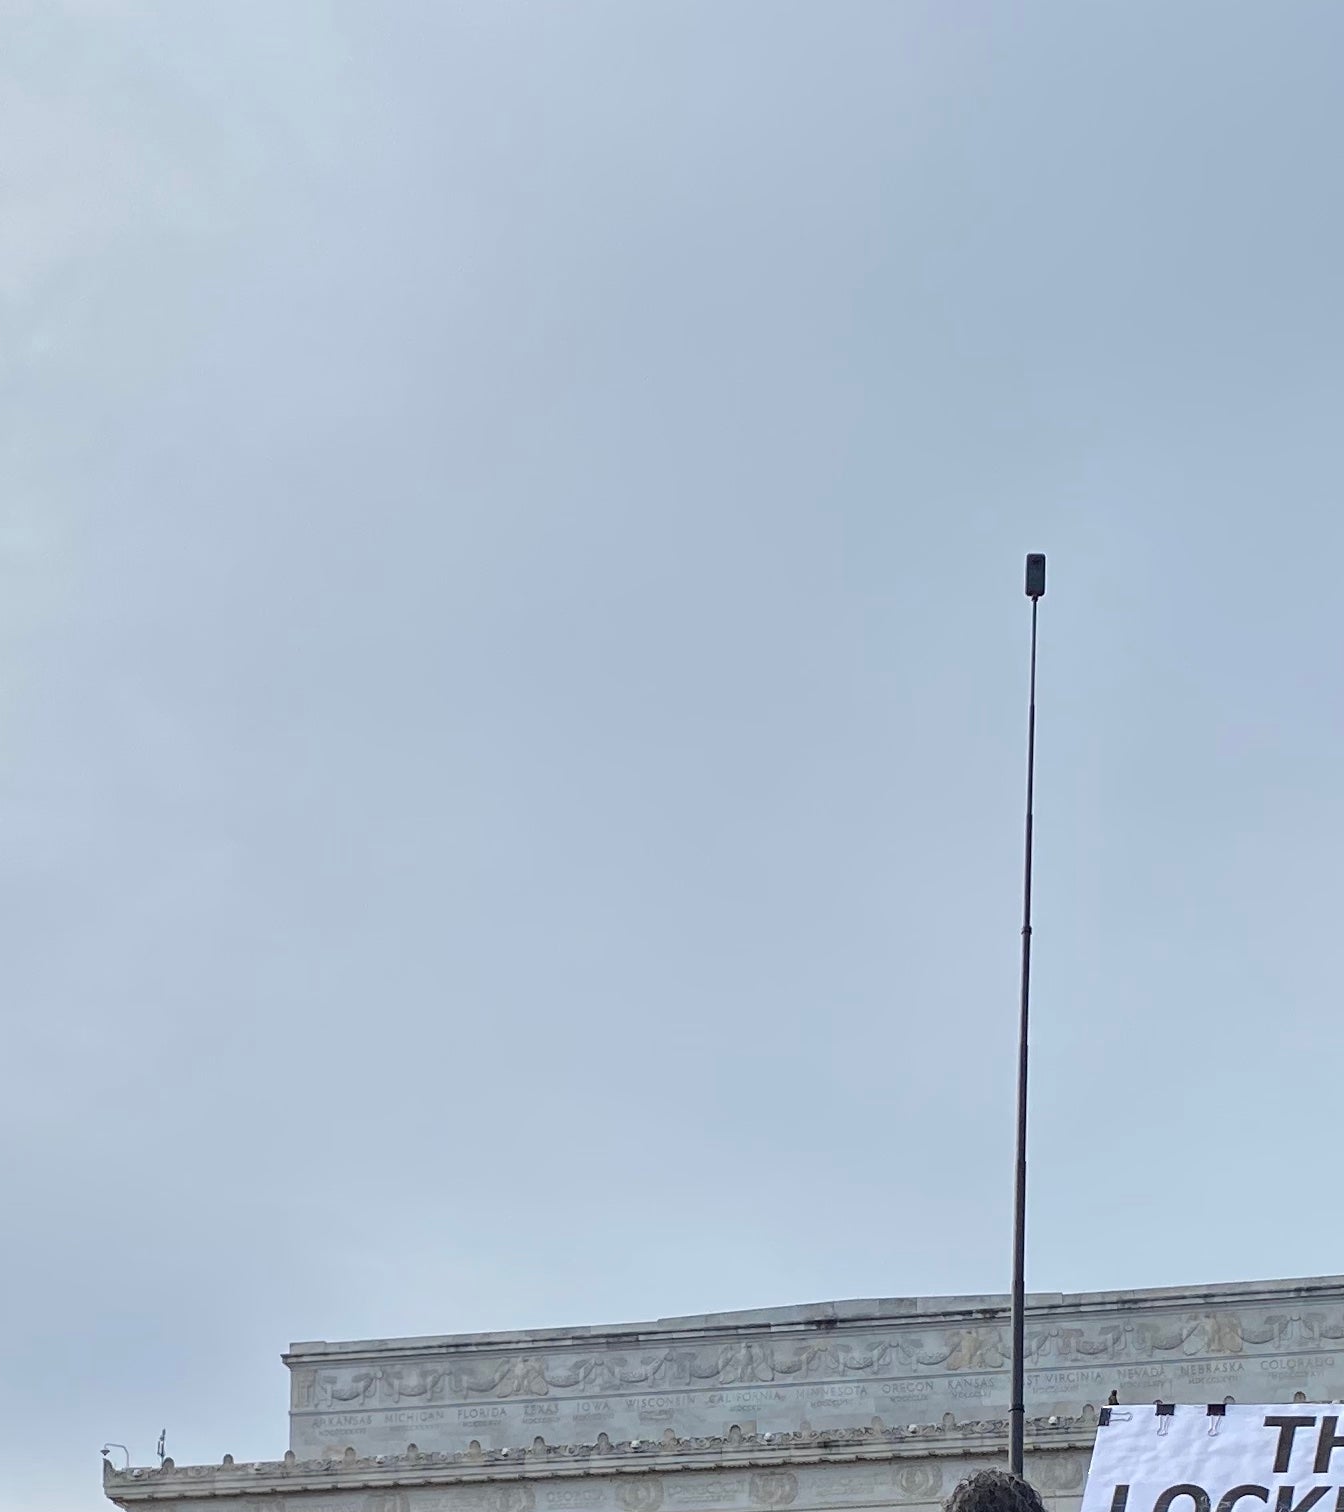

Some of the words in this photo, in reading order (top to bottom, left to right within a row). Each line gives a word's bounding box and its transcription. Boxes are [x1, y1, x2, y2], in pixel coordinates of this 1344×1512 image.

[1180, 1361, 1245, 1375] NEBRASKA
[1260, 1357, 1335, 1371] COLORADO
[1044, 1370, 1102, 1385] VIRGINIA
[1116, 1364, 1166, 1379] NEVADA
[881, 1380, 934, 1394] OREGON
[947, 1377, 995, 1391] KANSAS
[457, 1406, 507, 1420] FLORIDA
[576, 1401, 611, 1412] IOWA
[312, 1415, 373, 1428] ARKANSAS
[384, 1410, 444, 1424] MICHIGAN
